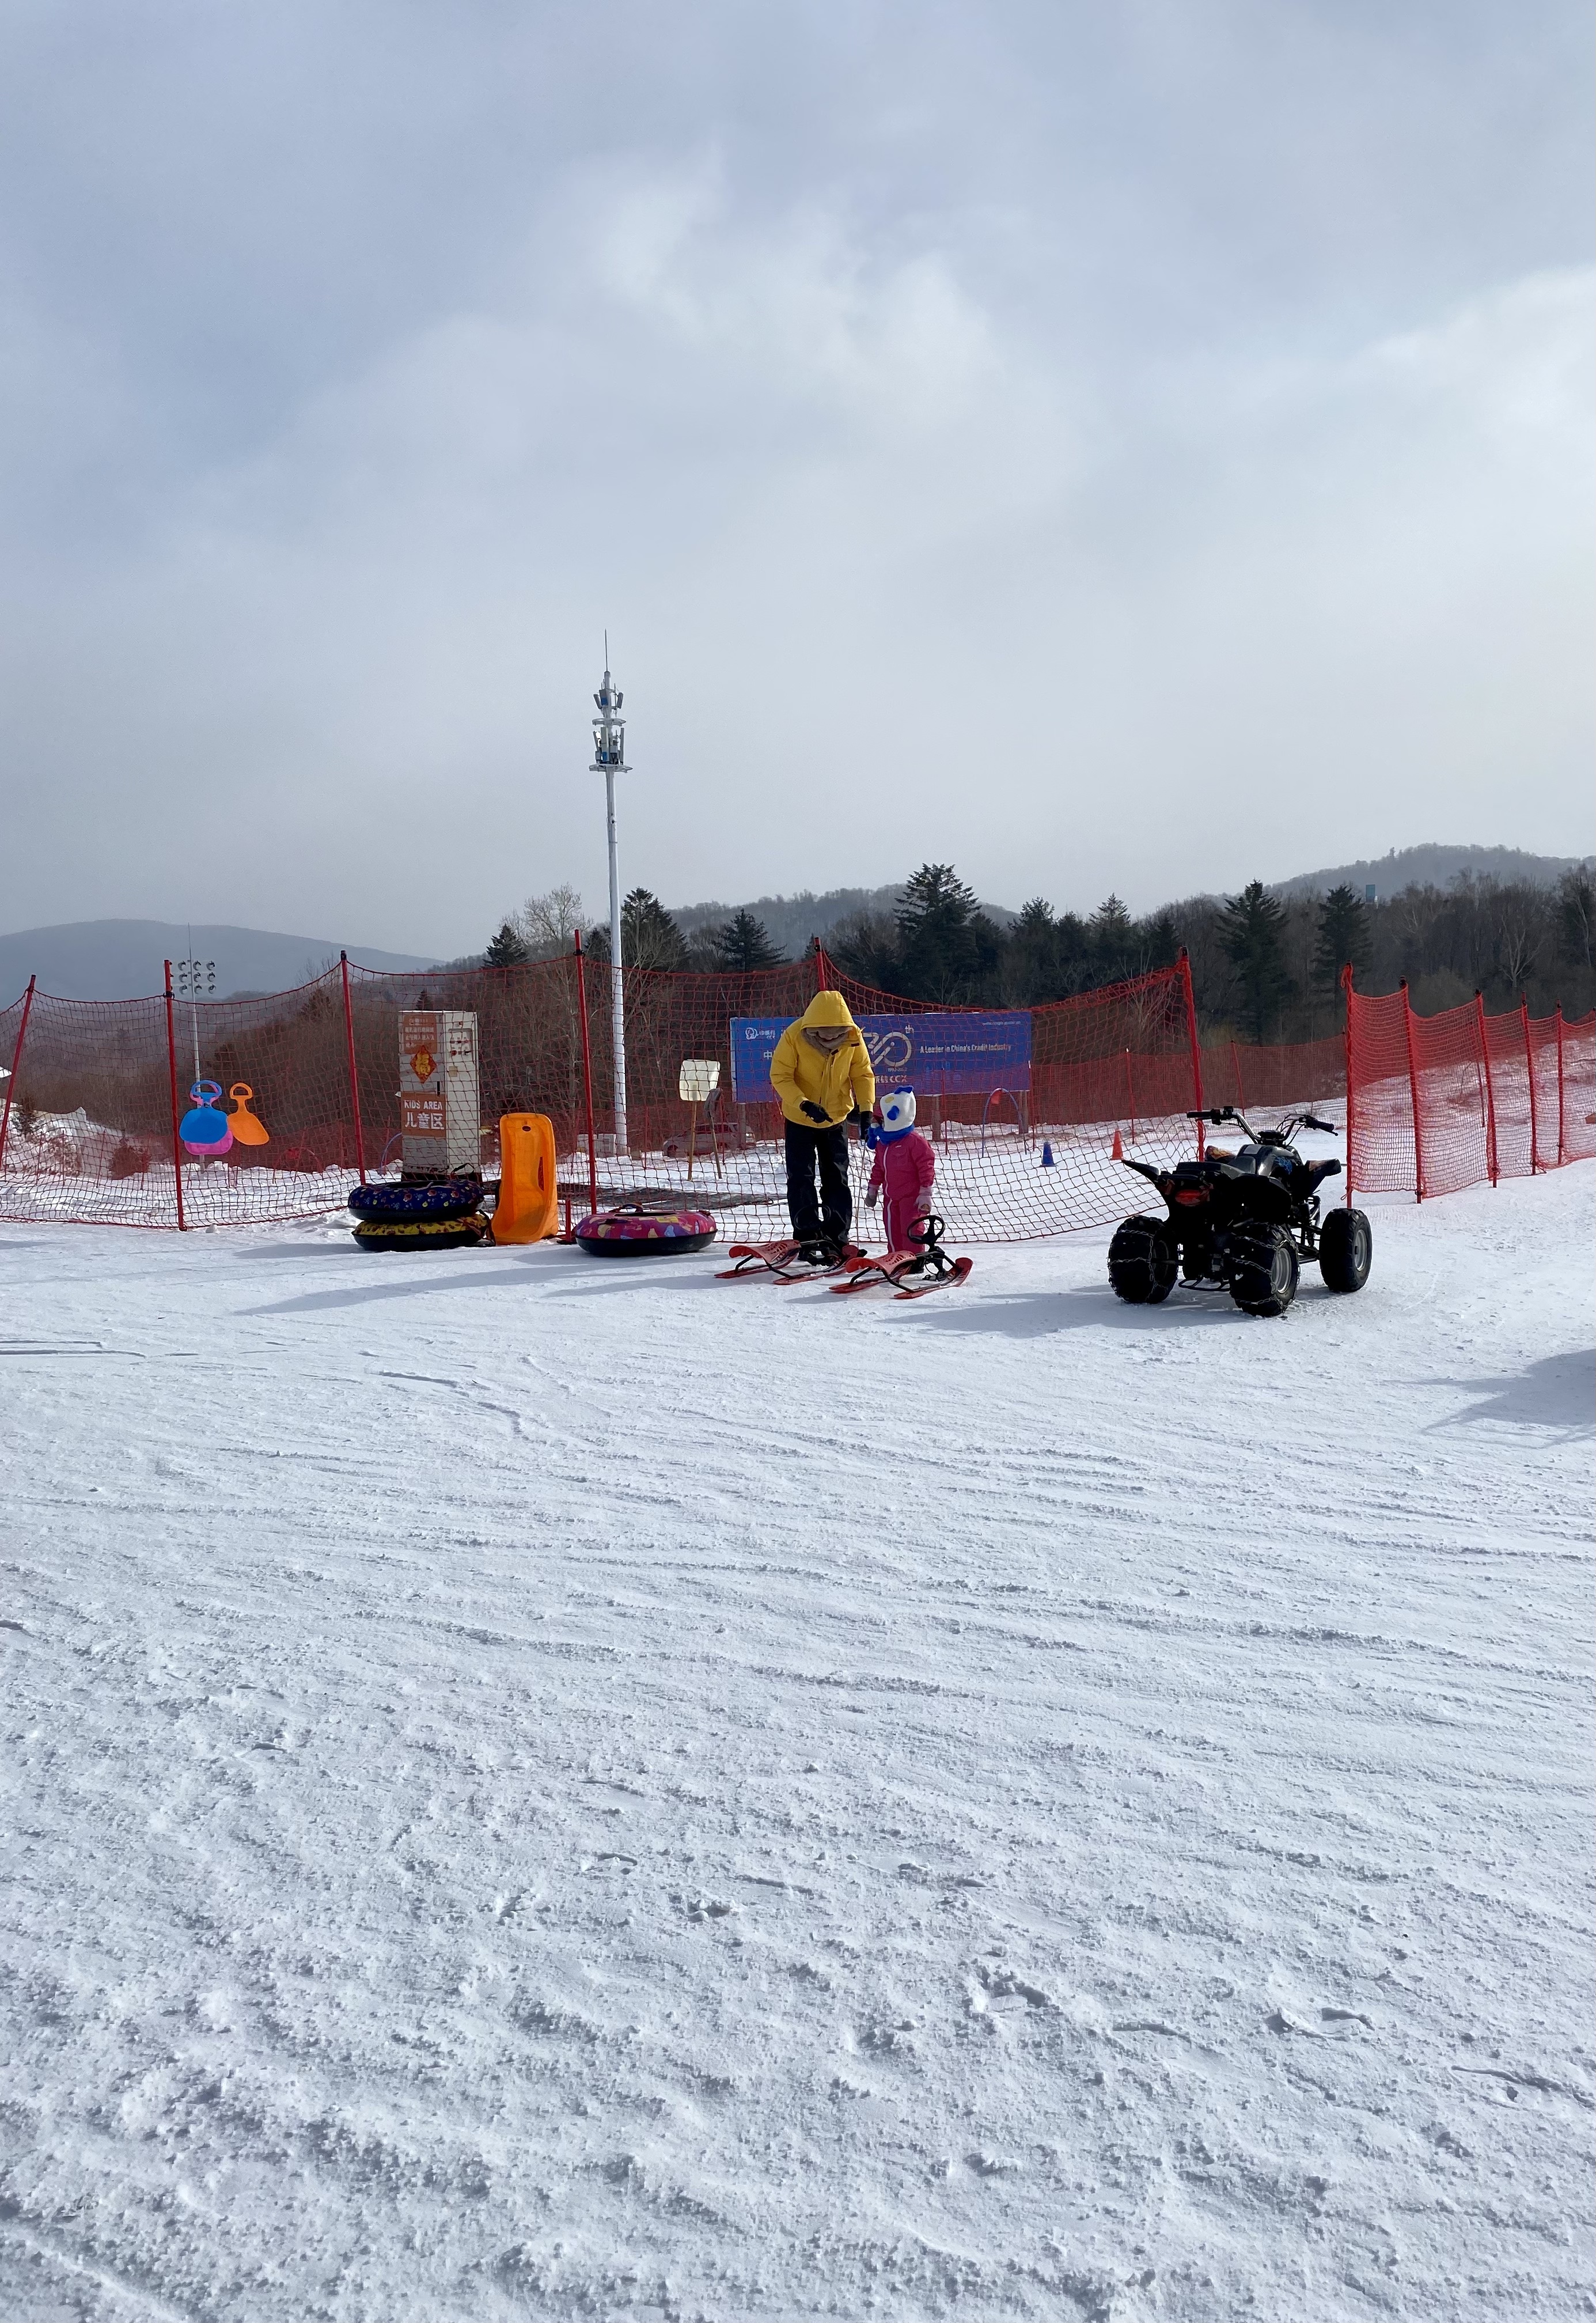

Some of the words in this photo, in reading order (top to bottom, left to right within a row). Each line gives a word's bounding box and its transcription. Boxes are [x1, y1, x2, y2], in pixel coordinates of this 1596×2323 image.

[905, 1024, 914, 1034] th
[925, 1045, 943, 1053] Leader
[951, 1044, 971, 1053] China's
[971, 1043, 987, 1051] Credit
[988, 1043, 1011, 1052] Industry
[889, 1075, 907, 1083] CCX
[404, 1099, 420, 1109] KIDS
[423, 1101, 443, 1110] AREA
[405, 1111, 445, 1130] 儿童区
